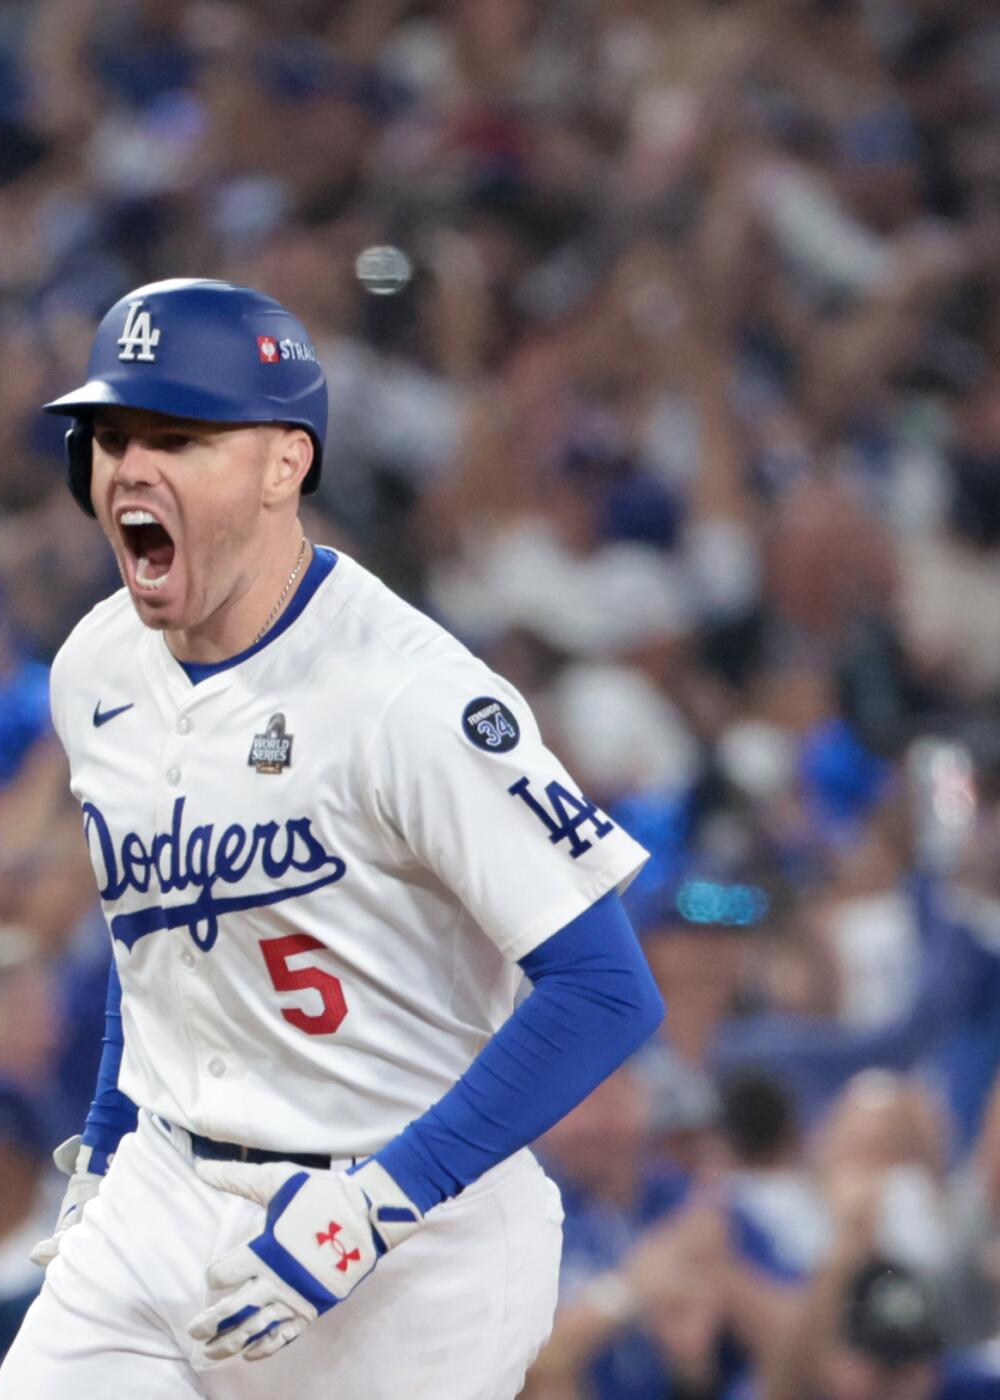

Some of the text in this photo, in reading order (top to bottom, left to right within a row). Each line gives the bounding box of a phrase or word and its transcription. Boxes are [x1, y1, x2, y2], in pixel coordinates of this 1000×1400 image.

[117, 300, 161, 360] LA
[251, 749, 287, 762] SERIES
[253, 738, 290, 752] WORLD
[476, 711, 517, 747] 34
[507, 775, 615, 860] LA
[82, 795, 347, 953] Dodgers
[258, 932, 349, 1035] 5
